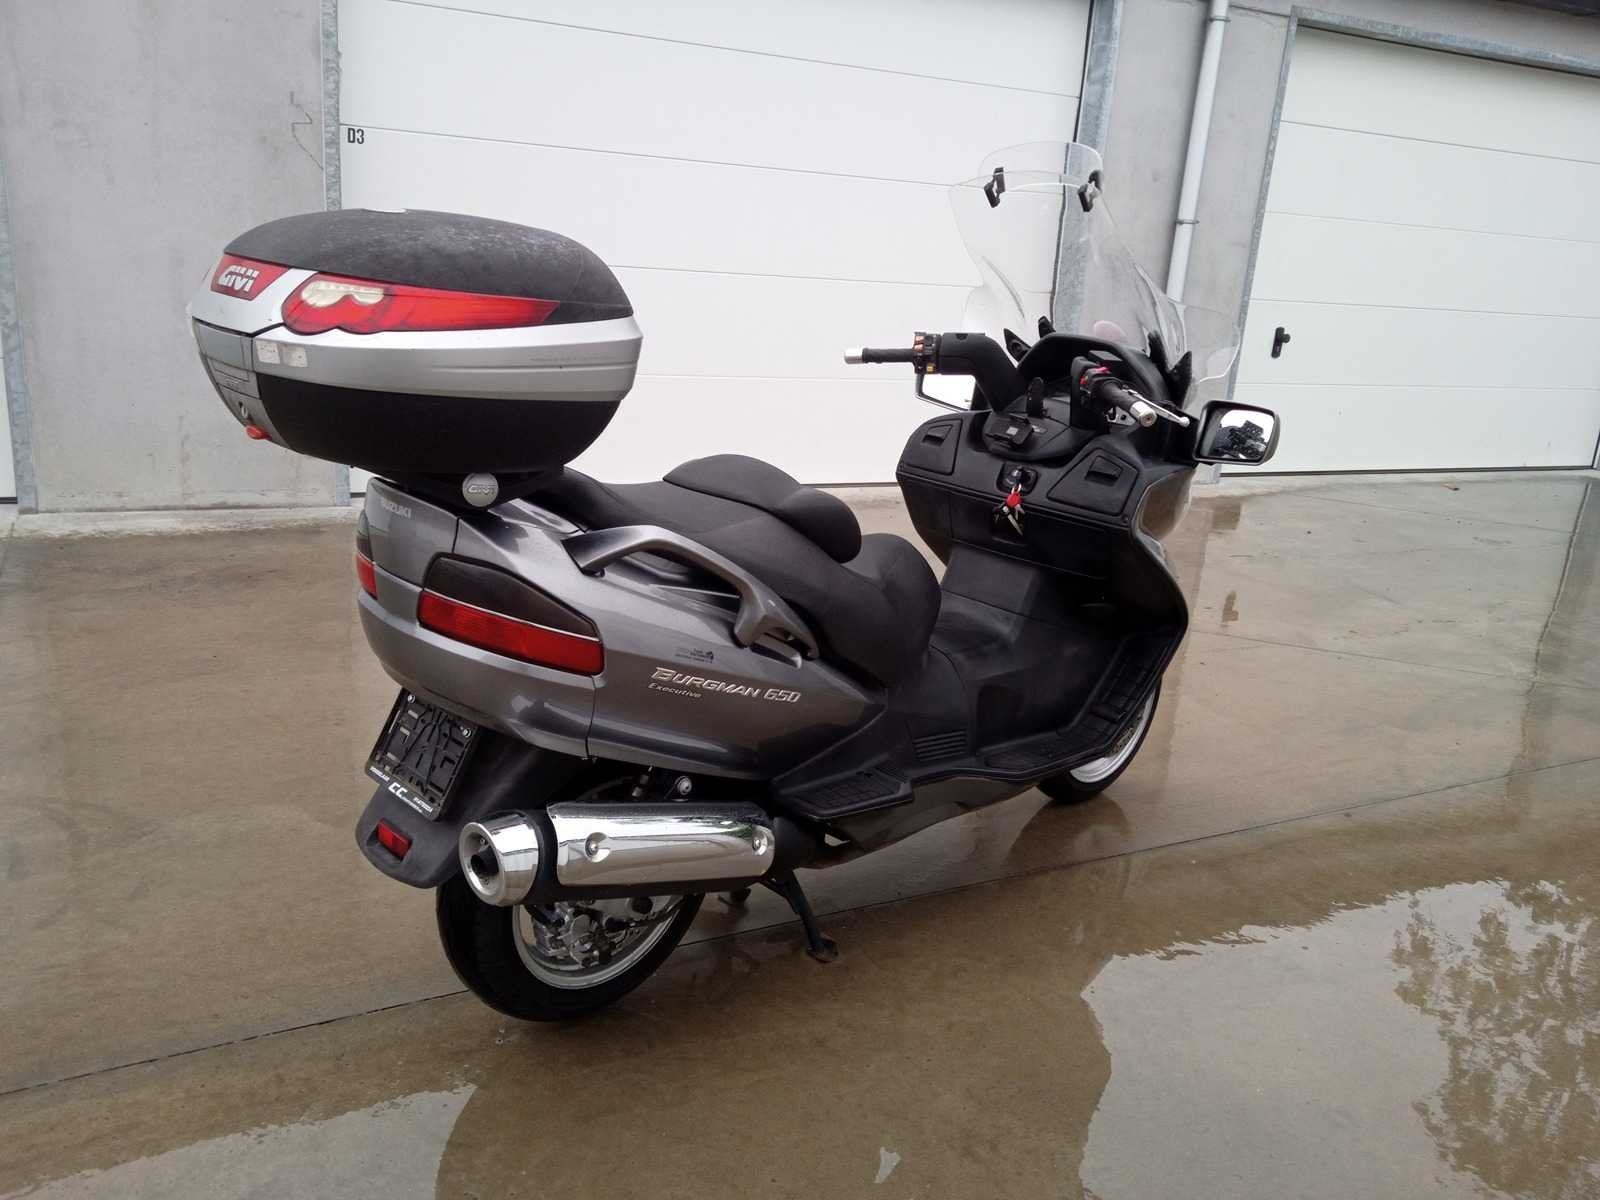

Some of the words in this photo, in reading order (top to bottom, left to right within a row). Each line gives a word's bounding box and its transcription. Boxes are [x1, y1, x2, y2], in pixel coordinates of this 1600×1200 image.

[347, 127, 365, 145] D3
[648, 682, 702, 699] Executive
[650, 666, 761, 698] BURGMAN
[763, 687, 802, 703] 650
